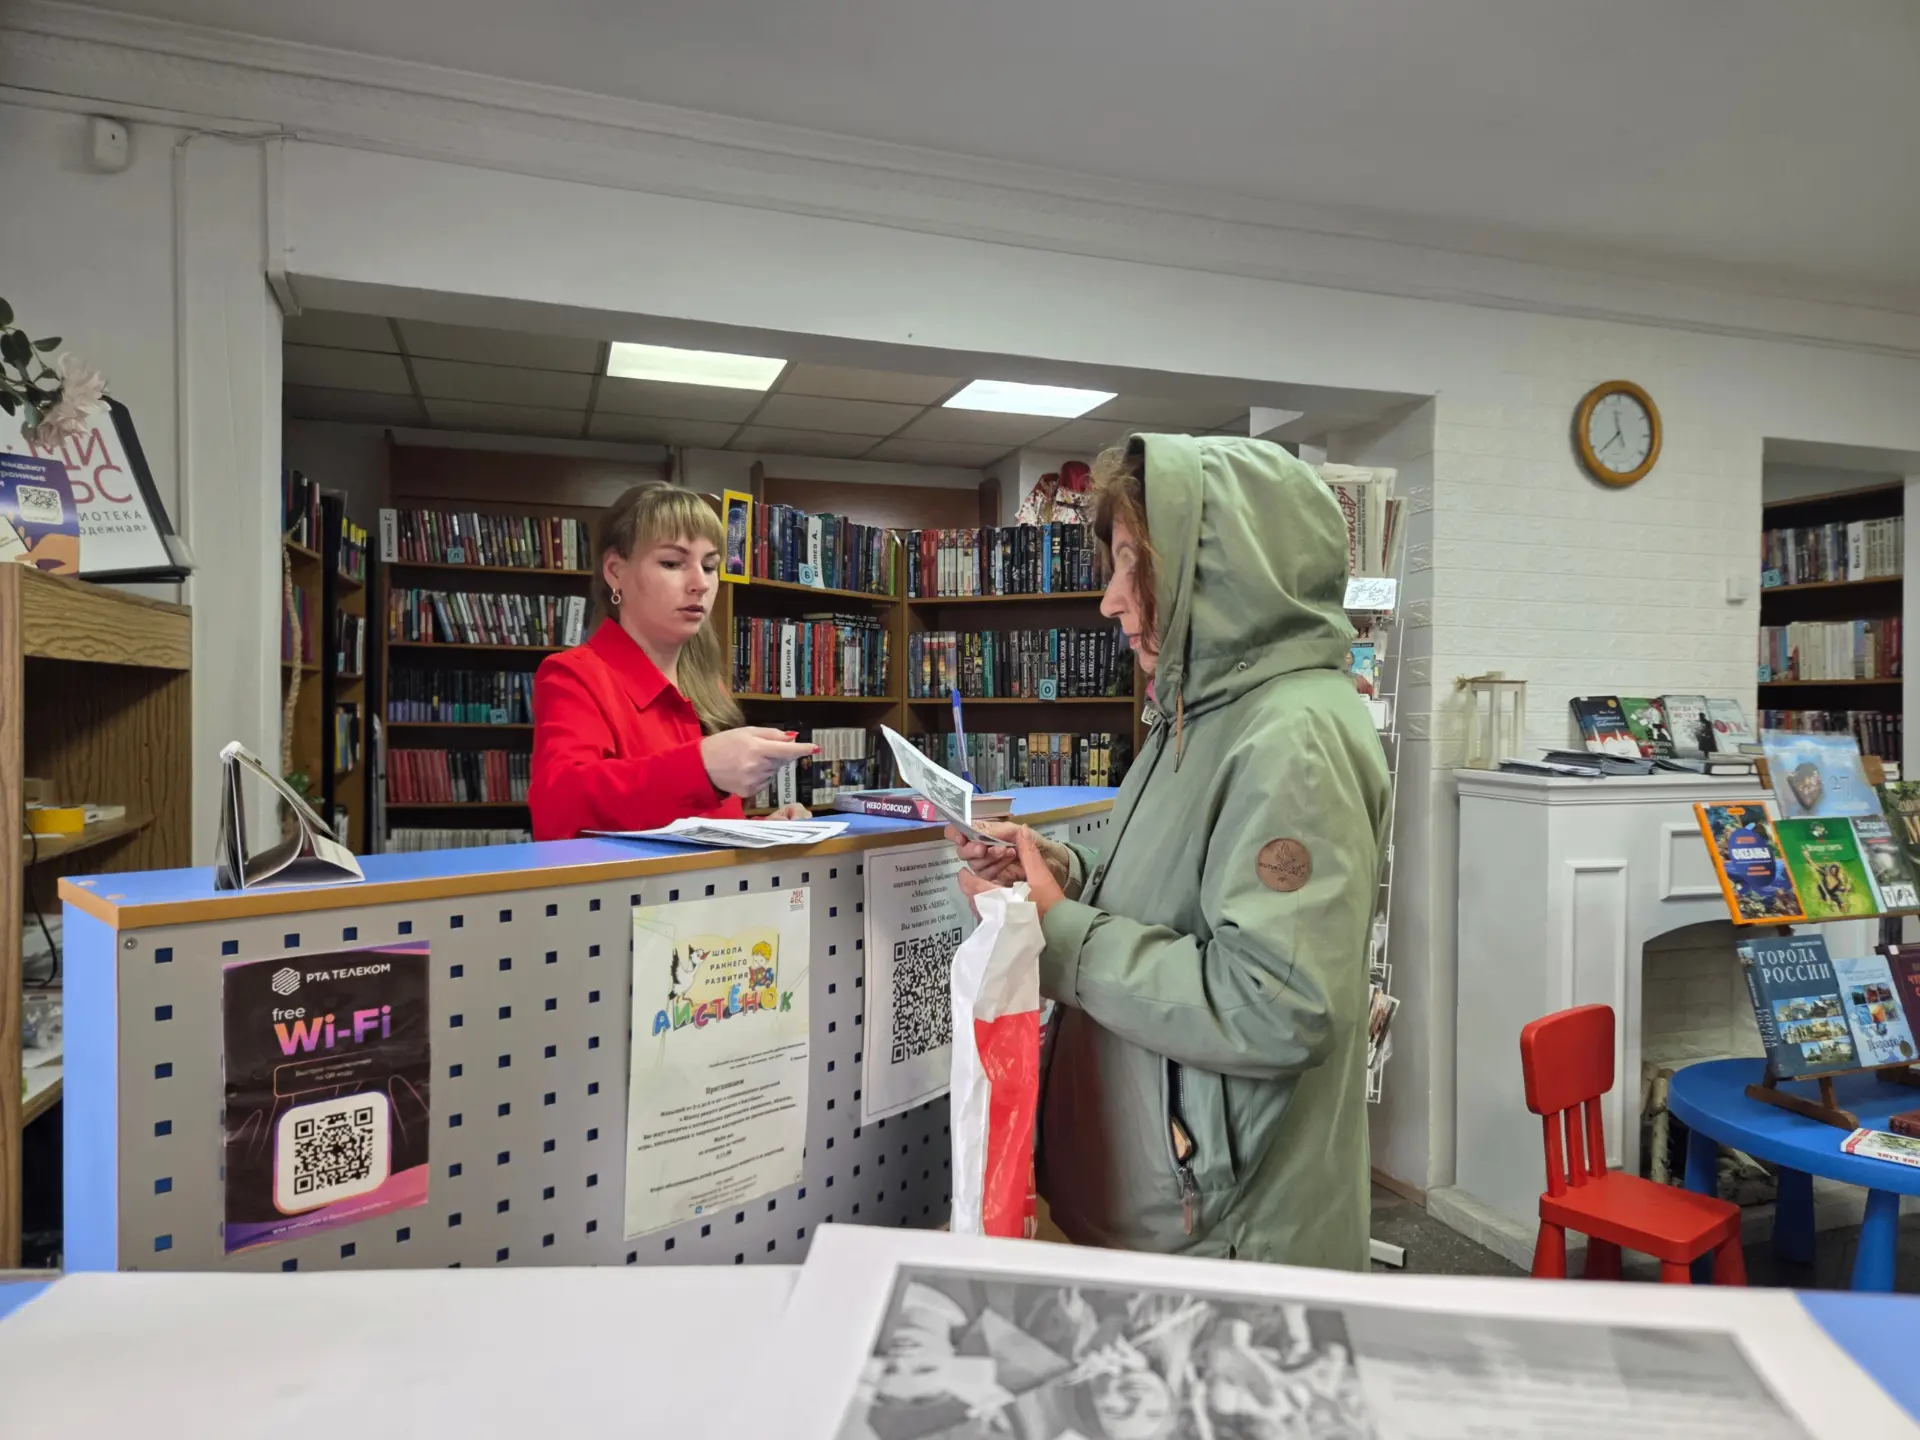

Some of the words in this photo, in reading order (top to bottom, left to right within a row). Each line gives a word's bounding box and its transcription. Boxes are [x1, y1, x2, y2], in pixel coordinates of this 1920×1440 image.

[78, 510, 142, 522] ИОТЕКА
[79, 524, 148, 536] одежная»
[783, 763, 791, 804] ГОЛОВАЧ
[866, 801, 881, 810] НЕБО
[881, 803, 912, 814] ПОВСЮДУ
[712, 947, 743, 957] ШКОЛА
[1757, 947, 1818, 966] ГОРОДА
[710, 958, 748, 971] РАННЕГО
[306, 971, 330, 983] РТА
[332, 963, 391, 979] ТЕЛЕКОМ
[705, 972, 749, 985] РАЗВИТИЯ
[1763, 964, 1831, 984] РОССИИ
[272, 1007, 306, 1022] free
[274, 1005, 391, 1056] Wi-Fi
